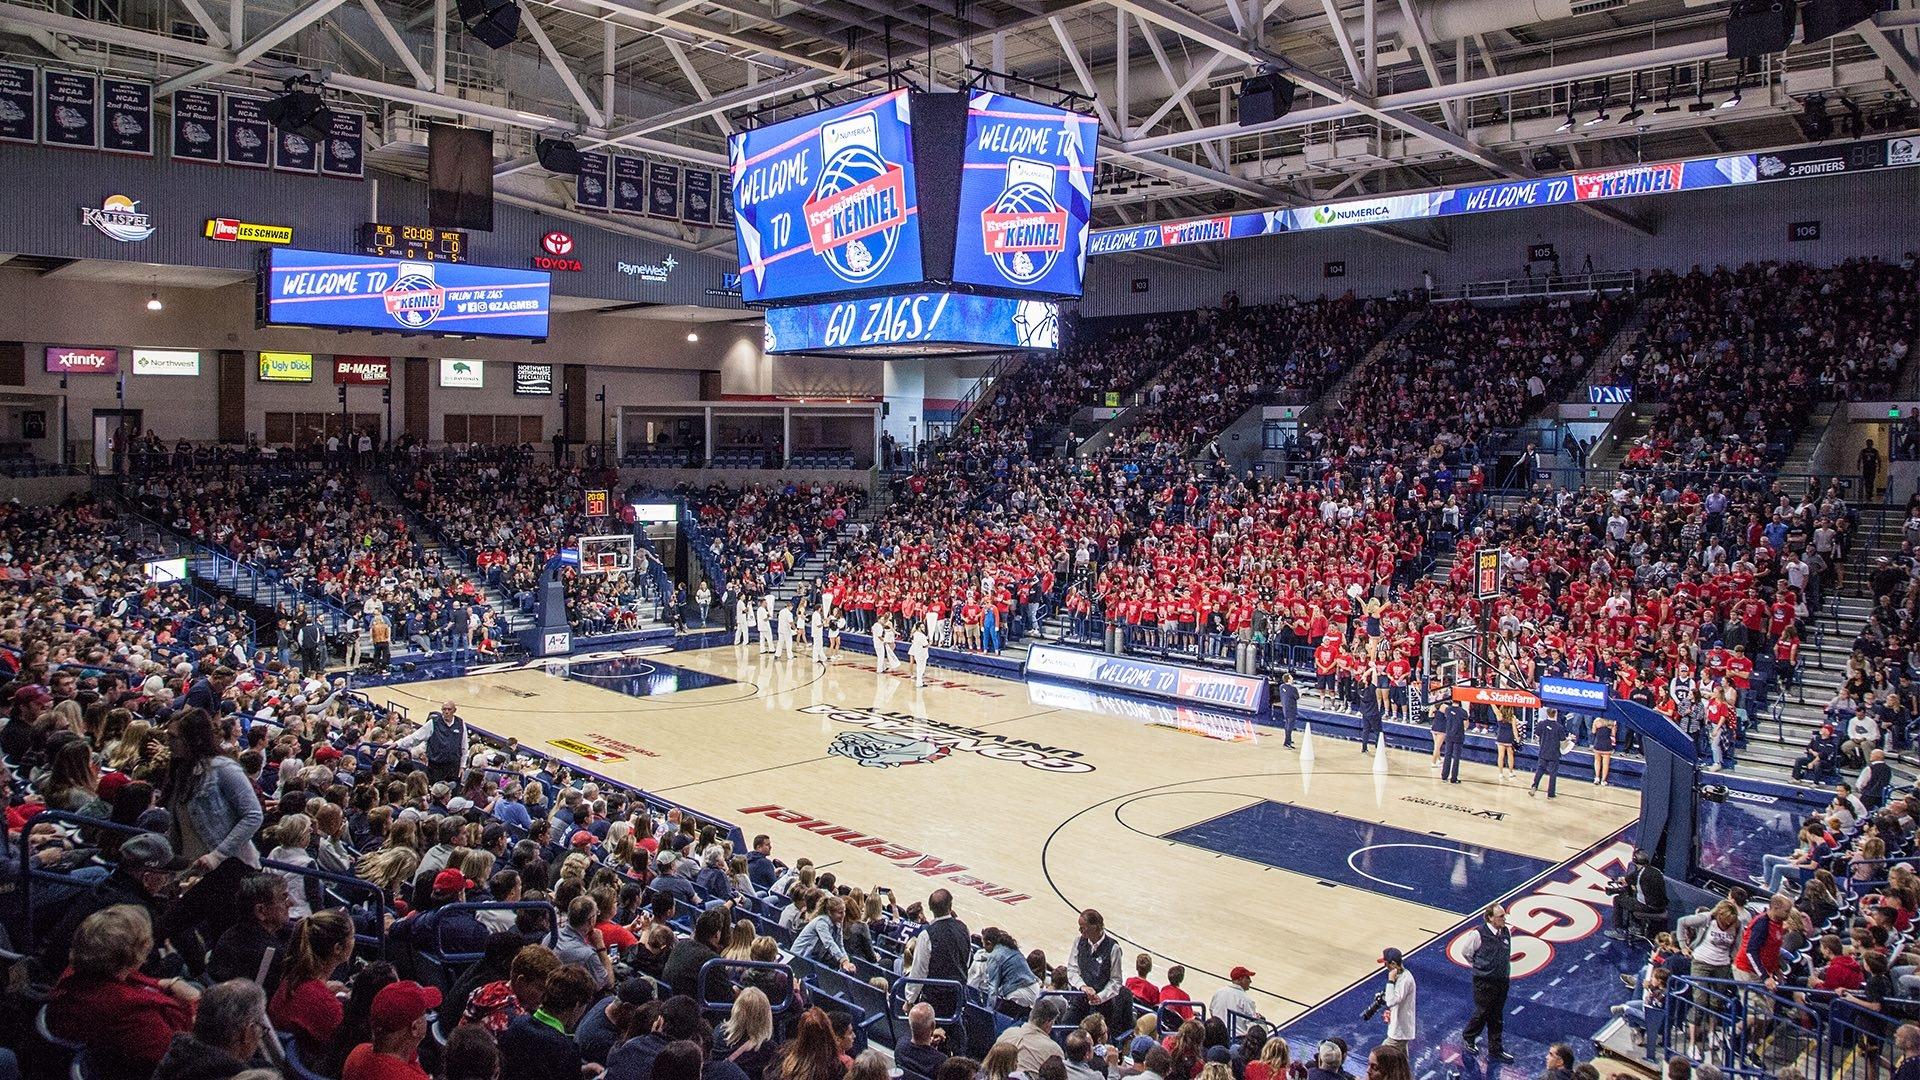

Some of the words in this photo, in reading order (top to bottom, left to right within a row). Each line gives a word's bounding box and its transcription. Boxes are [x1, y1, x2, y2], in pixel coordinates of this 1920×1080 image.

[58, 87, 83, 96] NCAA
[116, 94, 139, 103] NCAA
[66, 96, 93, 105] Round
[106, 101, 122, 109] 2nd
[123, 103, 148, 112] Round
[186, 104, 208, 112] NCAA
[237, 110, 259, 118] NCAA
[177, 110, 191, 118] 2nd
[193, 112, 216, 121] Round
[333, 123, 353, 131] NCAA
[840, 126, 872, 140] NUMERICA
[978, 123, 1053, 155] WELCOME
[1056, 130, 1077, 157] TO
[1789, 161, 1846, 176] 3-POINTERS
[741, 149, 810, 209] WELCOME
[1602, 168, 1673, 197] KENNEL
[1466, 182, 1541, 211] WELCOME
[1547, 181, 1568, 203] TO
[82, 207, 151, 227] KALISPEL
[832, 185, 899, 240] KENNEL
[1337, 206, 1390, 219] NUMERICA
[240, 228, 253, 237] LES
[254, 229, 290, 240] SCHWAB
[377, 225, 392, 234] BLUE
[403, 226, 434, 241] 20:08
[441, 232, 460, 241] WHITE
[771, 212, 791, 250] TO
[1005, 223, 1061, 247] KENNEL
[1178, 221, 1226, 243] KENNEL
[1795, 226, 1817, 237] 106
[385, 234, 393, 247] 0
[451, 241, 459, 253] 0
[1091, 230, 1140, 253] WELCOME
[1144, 229, 1158, 247] TO
[407, 249, 414, 259] 0
[427, 251, 434, 261] 0
[1534, 249, 1550, 258] 105
[534, 257, 583, 271] TOYOTA
[618, 261, 668, 277] PayneWest
[1329, 265, 1343, 273] 104
[282, 271, 361, 296] WELCOME
[367, 271, 388, 293] TO
[401, 294, 440, 308] KENNEL
[824, 303, 857, 347] GO
[860, 292, 950, 343] ZAGS!
[150, 359, 195, 367] Northwest
[271, 361, 288, 372] Ugly
[587, 492, 605, 501] 20:08
[589, 501, 603, 513] 30
[1099, 664, 1155, 689] WELCOME
[1156, 671, 1175, 690] TO
[1194, 682, 1249, 705] KENNEL
[1542, 684, 1604, 700] GOZAGS.COM
[796, 703, 1097, 774] GONZAGA
[736, 804, 969, 877] Kennel
[948, 874, 1032, 905] The
[897, 926, 914, 944] 5
